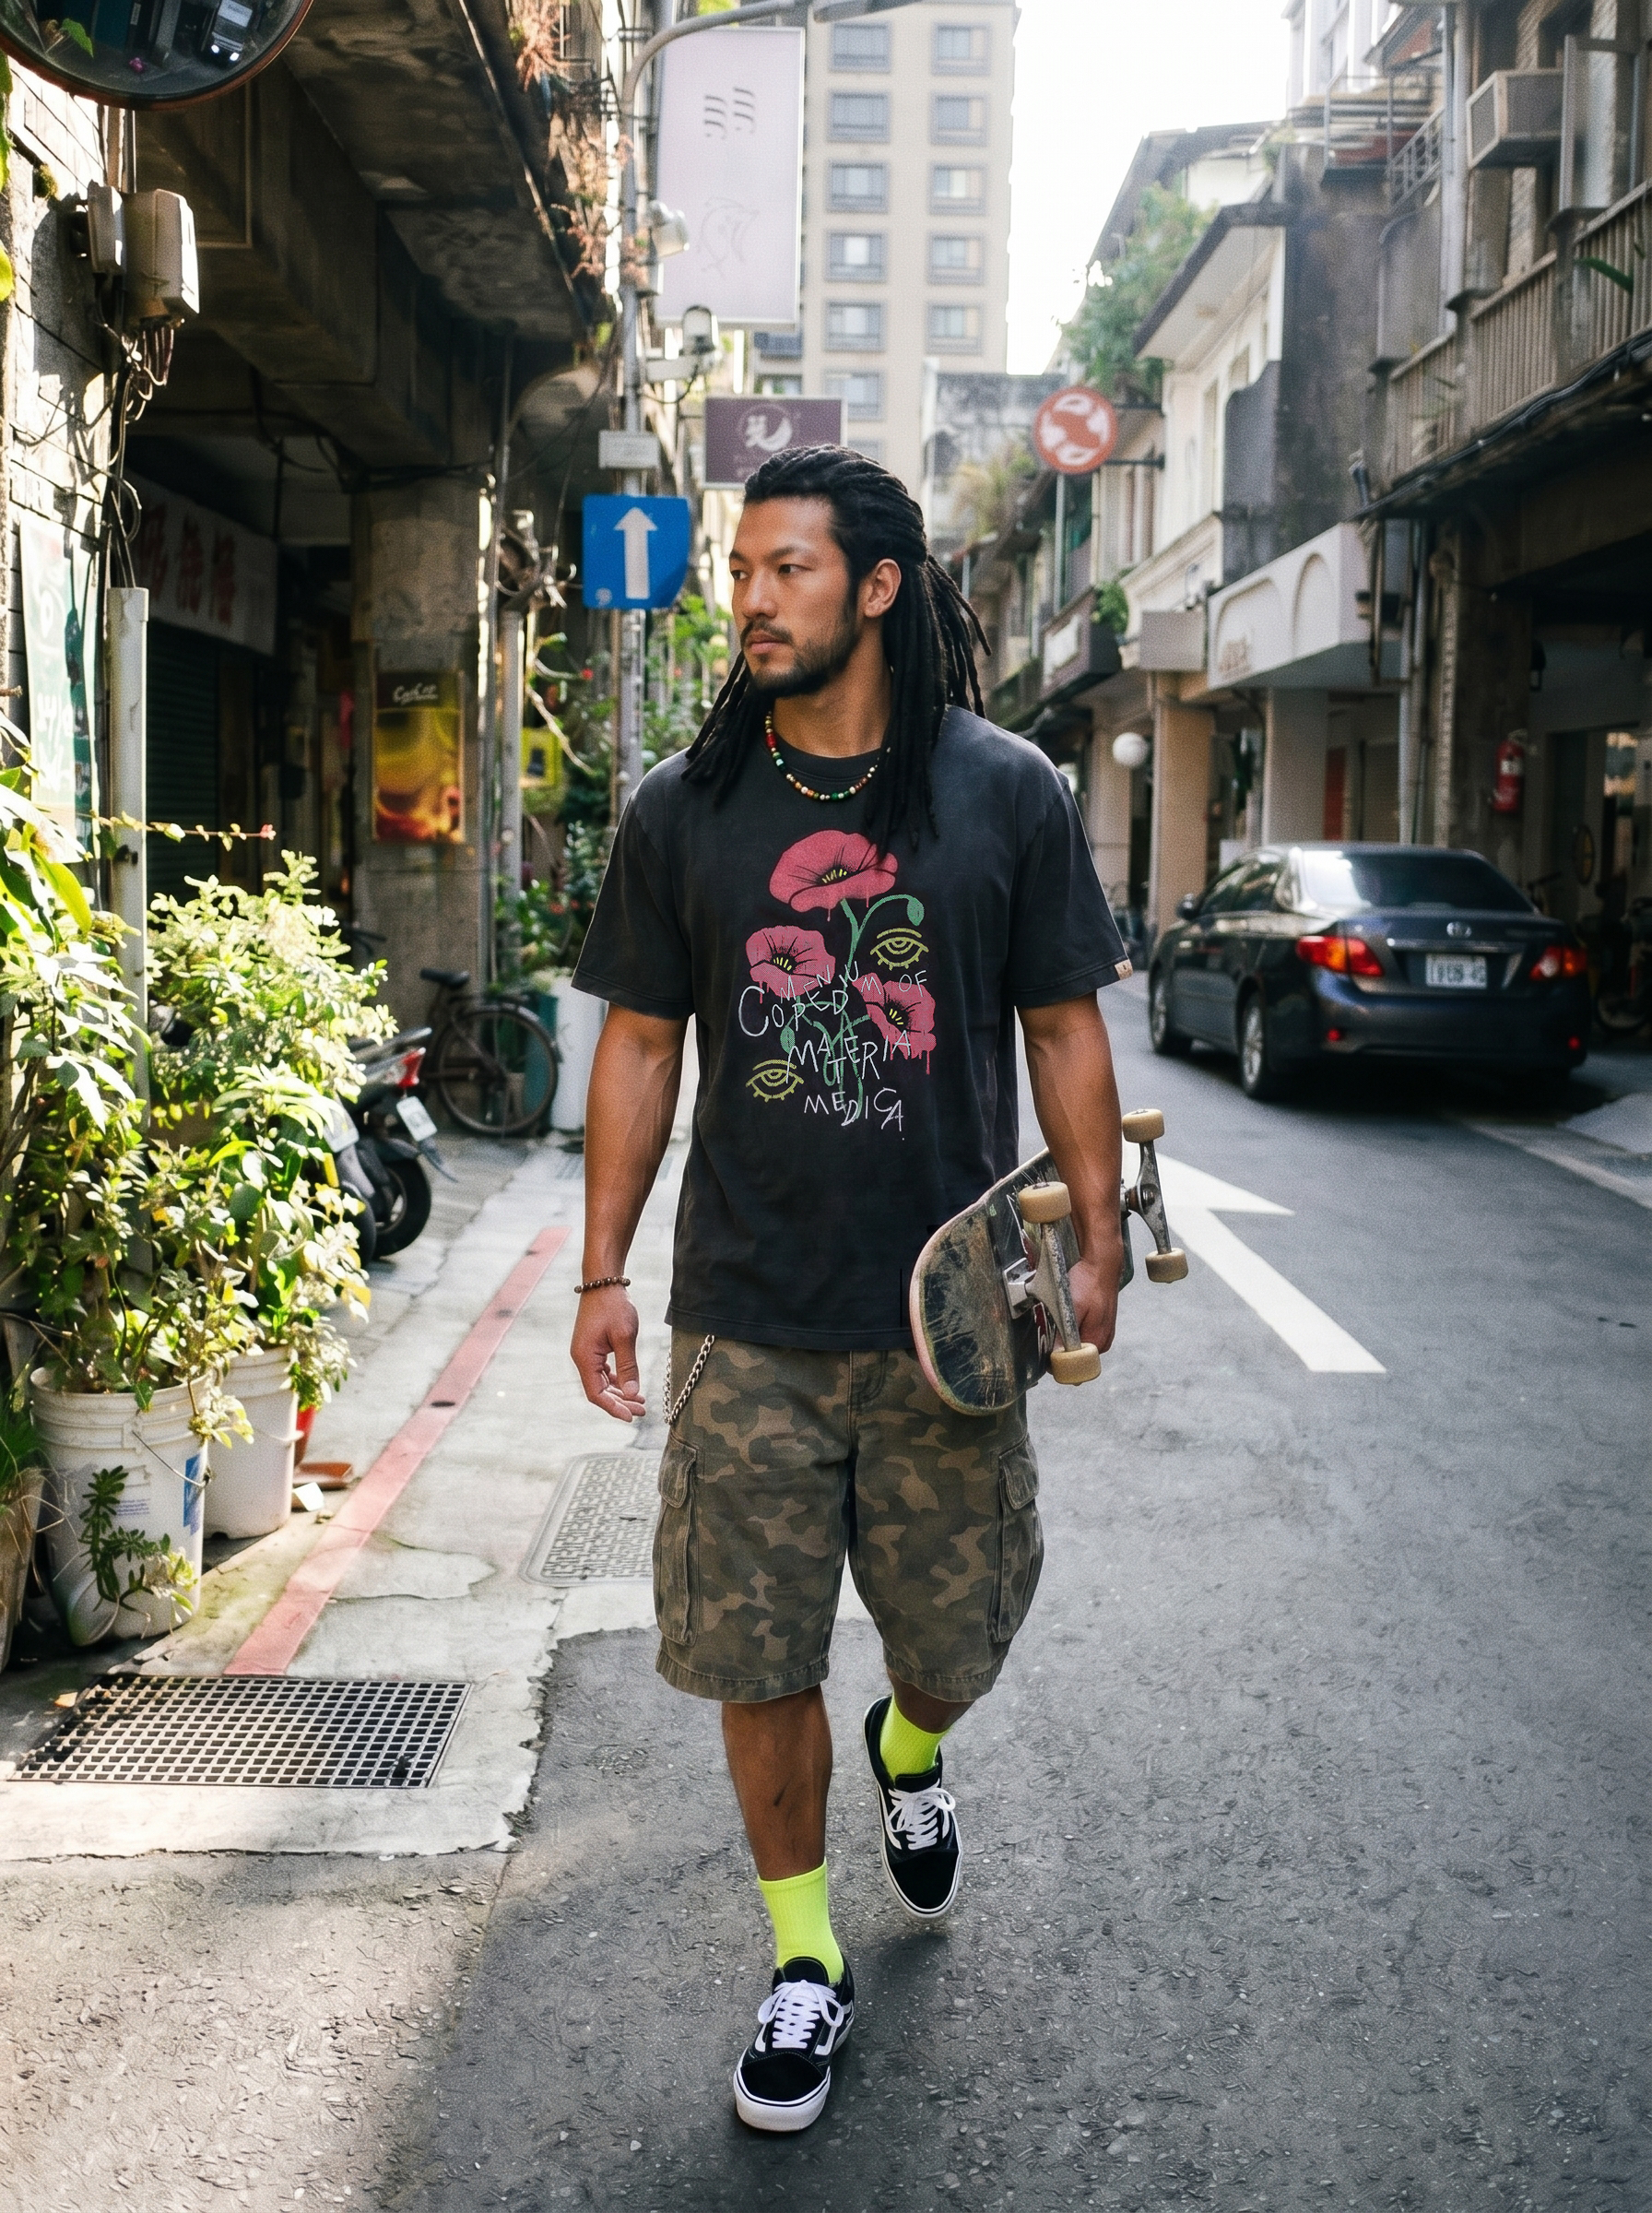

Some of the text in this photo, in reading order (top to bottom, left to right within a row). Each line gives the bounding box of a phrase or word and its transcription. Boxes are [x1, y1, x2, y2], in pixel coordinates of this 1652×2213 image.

[898, 970, 927, 997] OF
[785, 1030, 912, 1084] MATERIA
[804, 1087, 904, 1132] MEDICA
